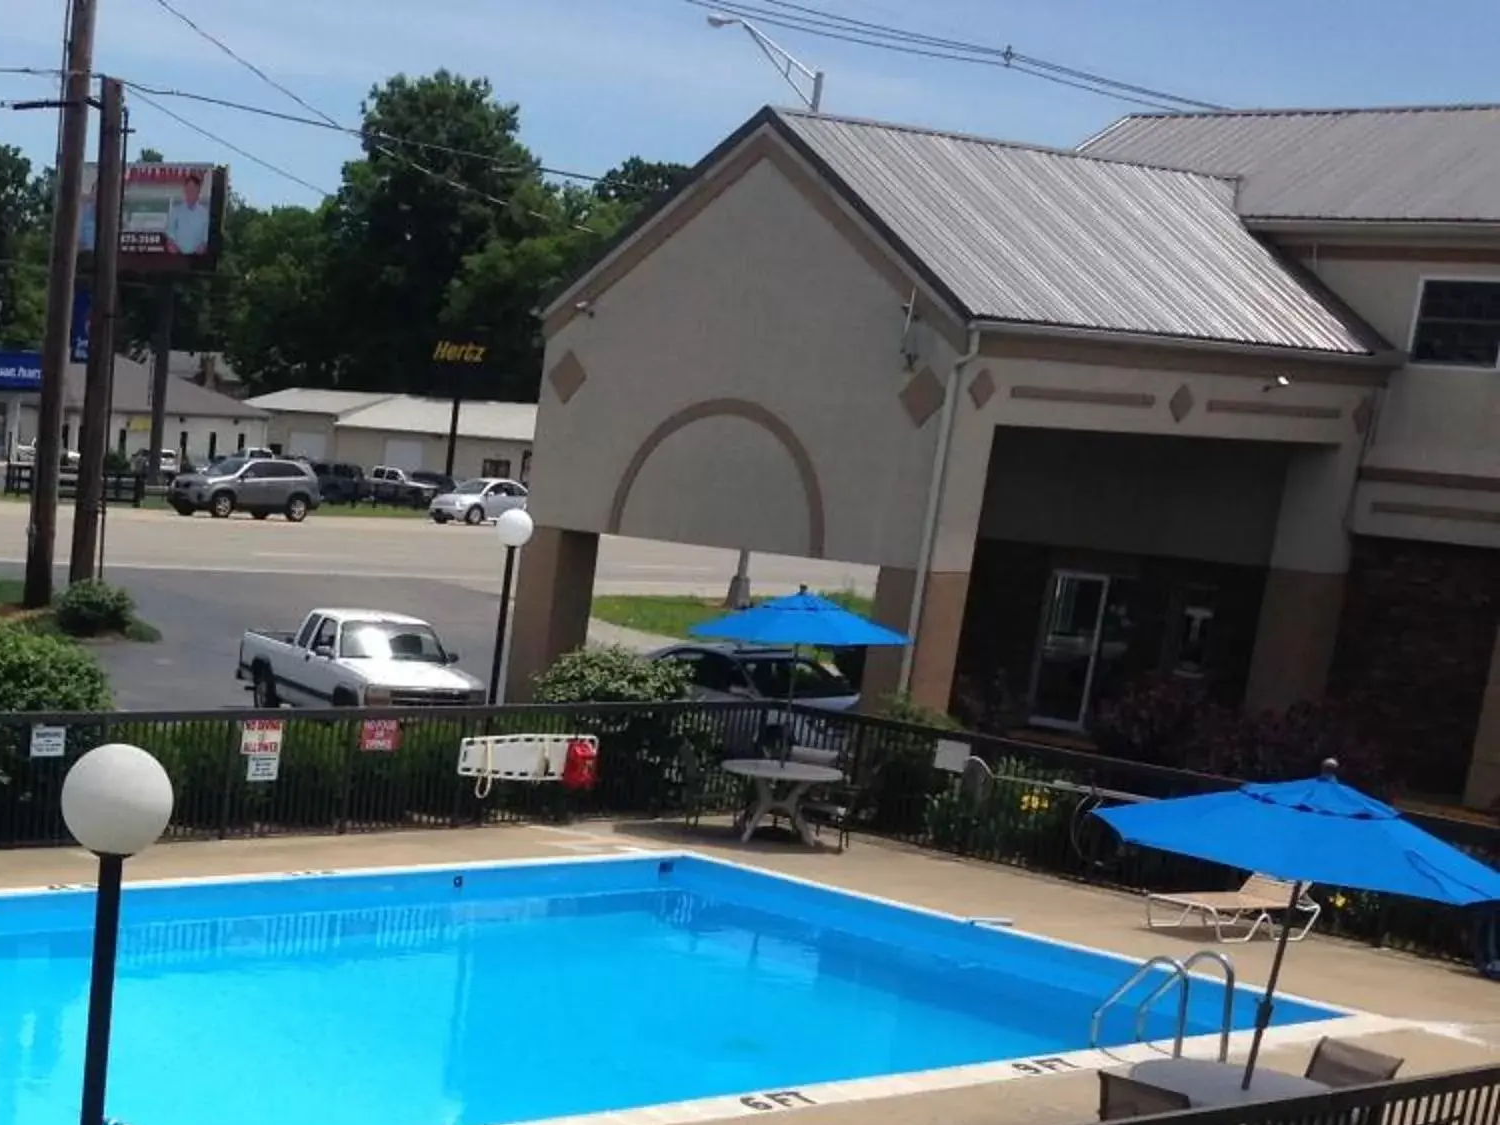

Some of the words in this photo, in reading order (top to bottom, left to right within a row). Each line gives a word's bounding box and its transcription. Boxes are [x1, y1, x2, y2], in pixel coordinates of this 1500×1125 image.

[432, 340, 486, 362] Hertz
[1032, 1057, 1081, 1070] FT
[740, 1096, 773, 1110] 6
[763, 1091, 818, 1107] FT
